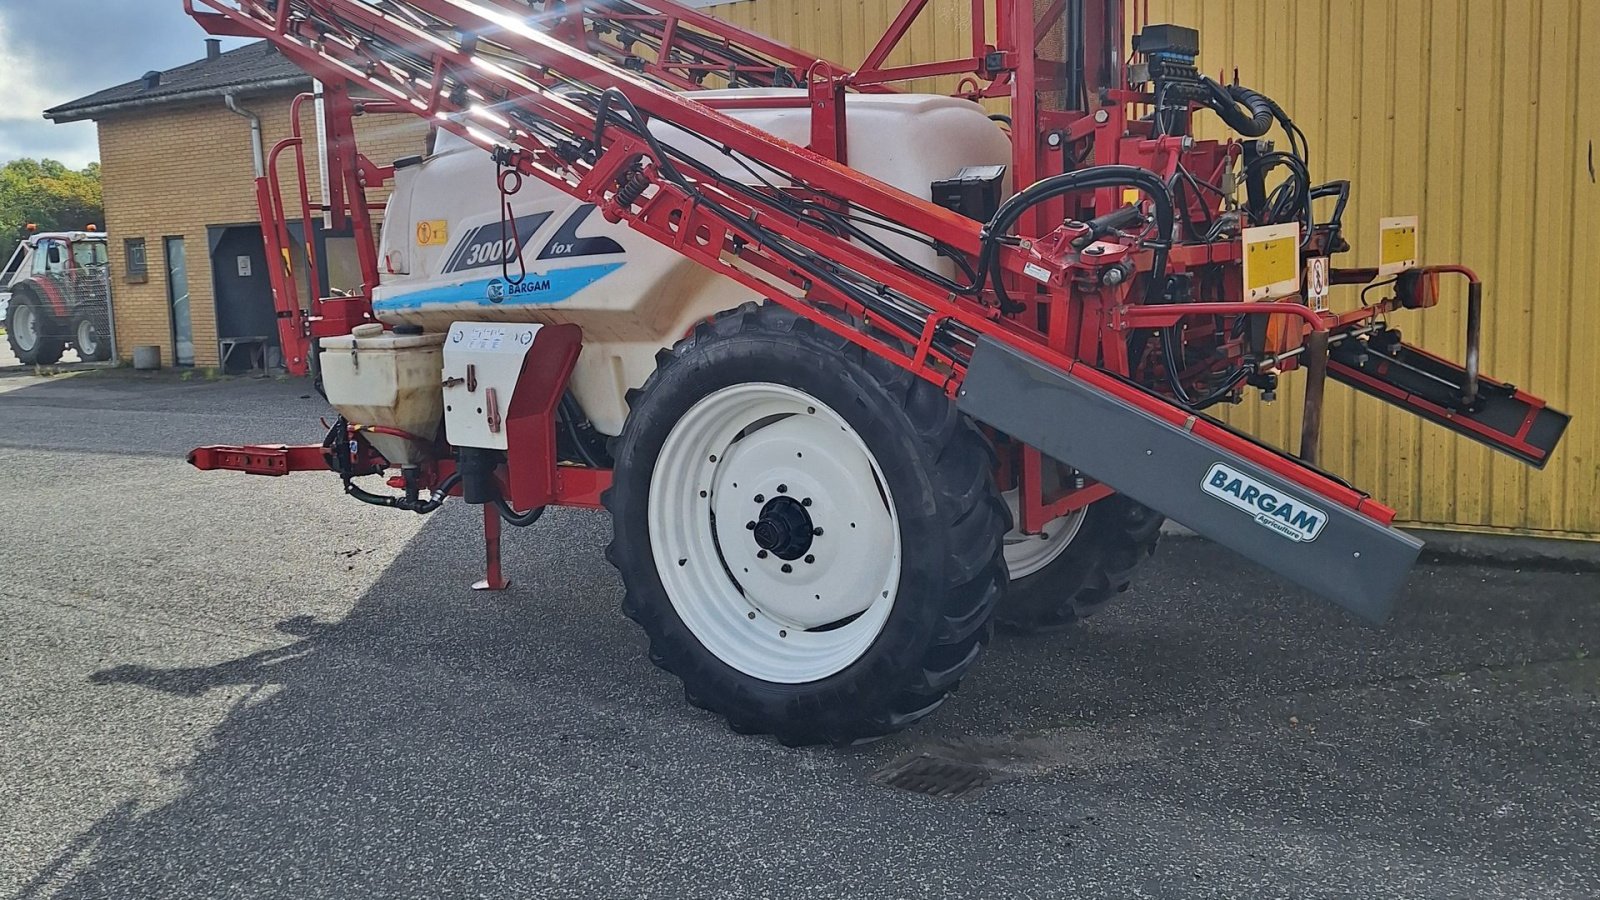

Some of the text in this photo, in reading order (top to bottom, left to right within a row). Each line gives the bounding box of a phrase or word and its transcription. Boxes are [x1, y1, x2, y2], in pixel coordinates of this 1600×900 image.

[466, 237, 516, 265] 3000
[550, 241, 574, 255] fox
[508, 279, 551, 295] BARGAM
[1209, 469, 1319, 535] BARGAM
[1258, 515, 1301, 540] Agriculture
